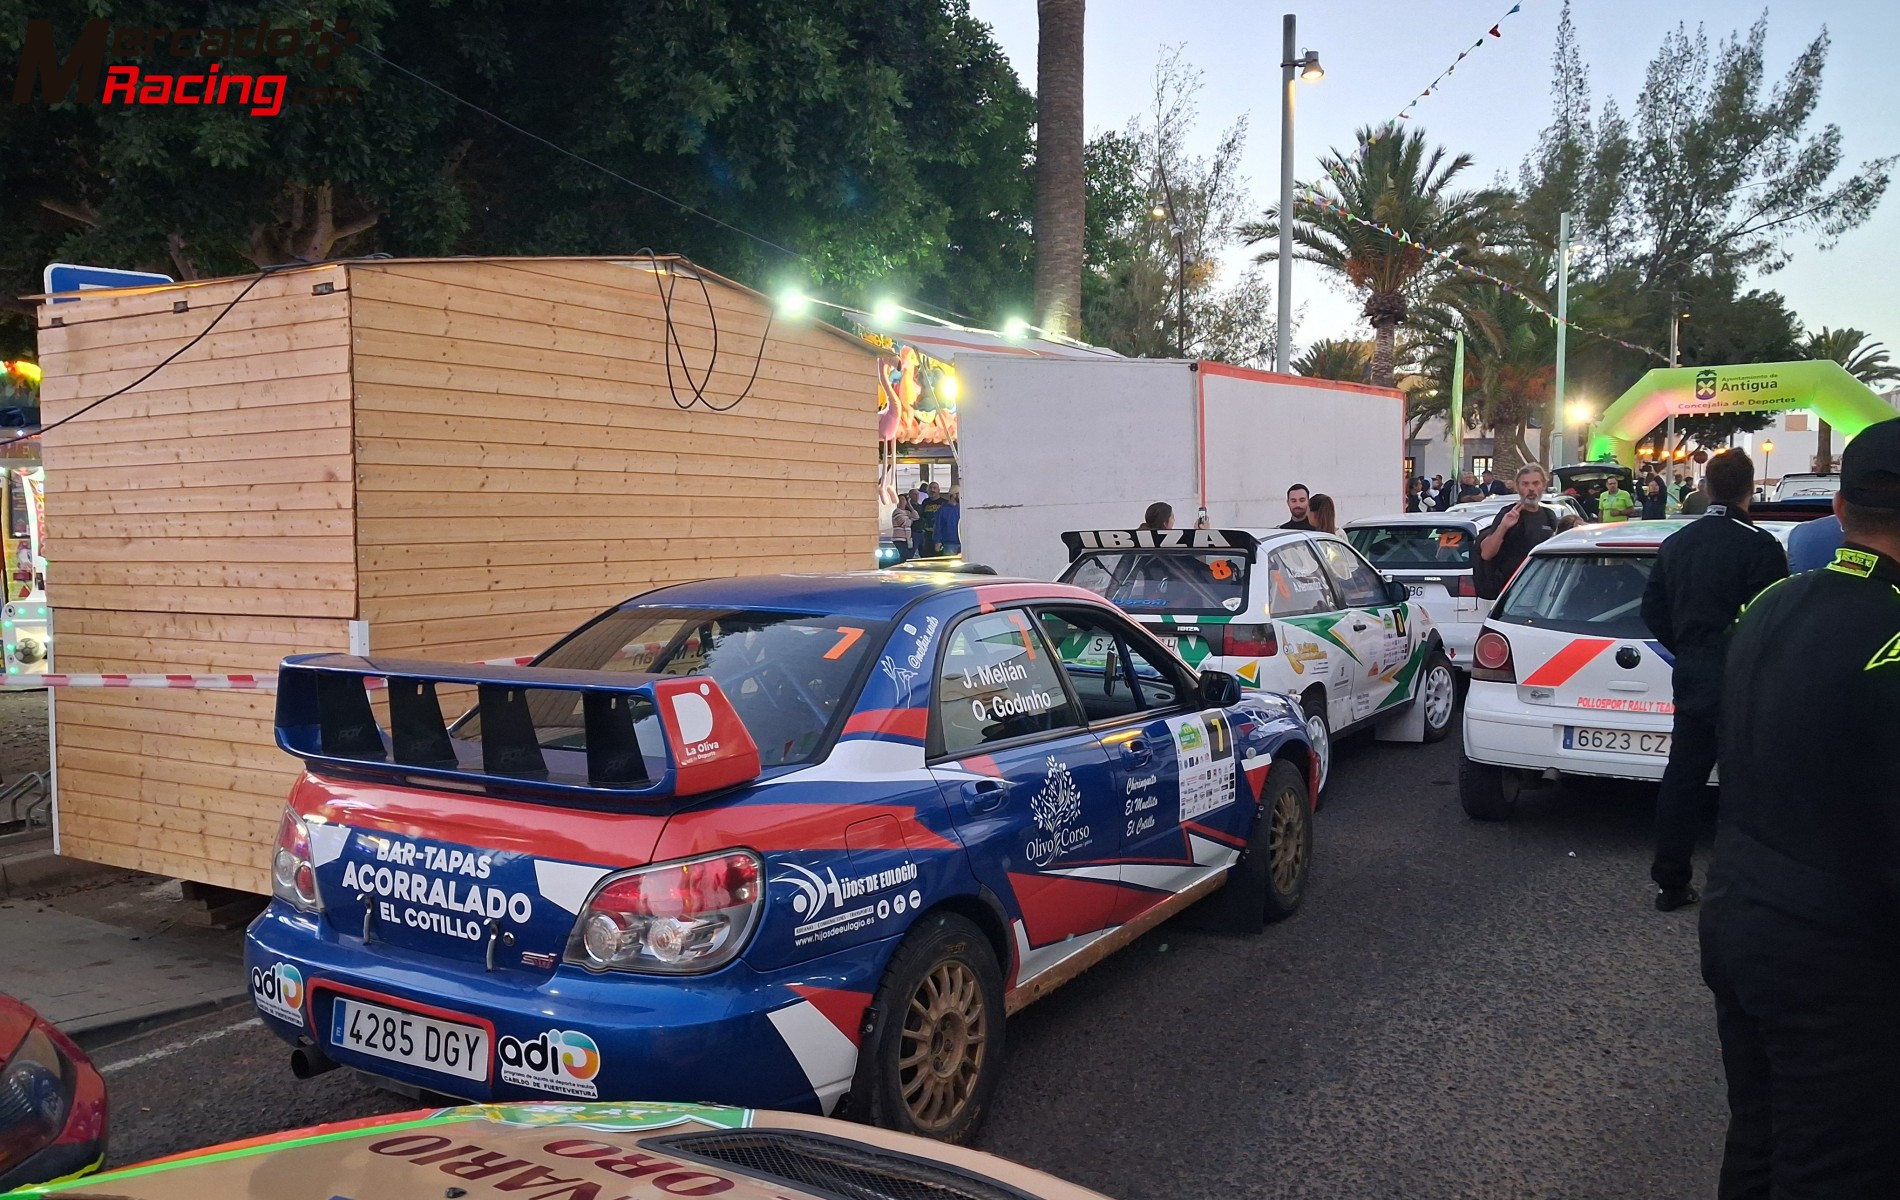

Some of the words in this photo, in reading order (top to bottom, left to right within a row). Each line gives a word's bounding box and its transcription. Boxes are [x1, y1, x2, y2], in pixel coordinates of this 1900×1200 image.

[1720, 379, 1778, 393] Antigua
[1748, 397, 1797, 406] Deportes
[1079, 530, 1231, 548] IBIZA
[1440, 532, 1463, 547] 12
[1208, 559, 1233, 580] 8
[1407, 586, 1424, 596] BG
[823, 626, 865, 660] 7
[1007, 613, 1037, 660] 7
[962, 668, 978, 689] J.
[980, 660, 1028, 686] Melián
[972, 700, 991, 722] O.
[992, 690, 1052, 718] Godinho
[1577, 696, 1628, 712] POLLOSPORT
[1628, 700, 1656, 712] RALLY
[1210, 718, 1224, 752] 7
[1578, 729, 1632, 750] 6623
[1639, 734, 1668, 754] CZ
[685, 747, 697, 757] La
[697, 741, 720, 753] Oliva
[1124, 799, 1134, 816] El
[1126, 820, 1136, 837] El
[1026, 838, 1054, 861] Olivo
[1061, 825, 1090, 847] Corso
[376, 838, 492, 879] BAR-TAPAS
[342, 860, 532, 924] ACORRALADO
[865, 873, 880, 894] DE
[379, 901, 401, 924] EL
[404, 908, 481, 942] COTILLO
[349, 1009, 414, 1057] 4285
[424, 1025, 480, 1072] DGY
[504, 1076, 530, 1086] CABILDO
[544, 1084, 597, 1098] FUERTEVENTURA
